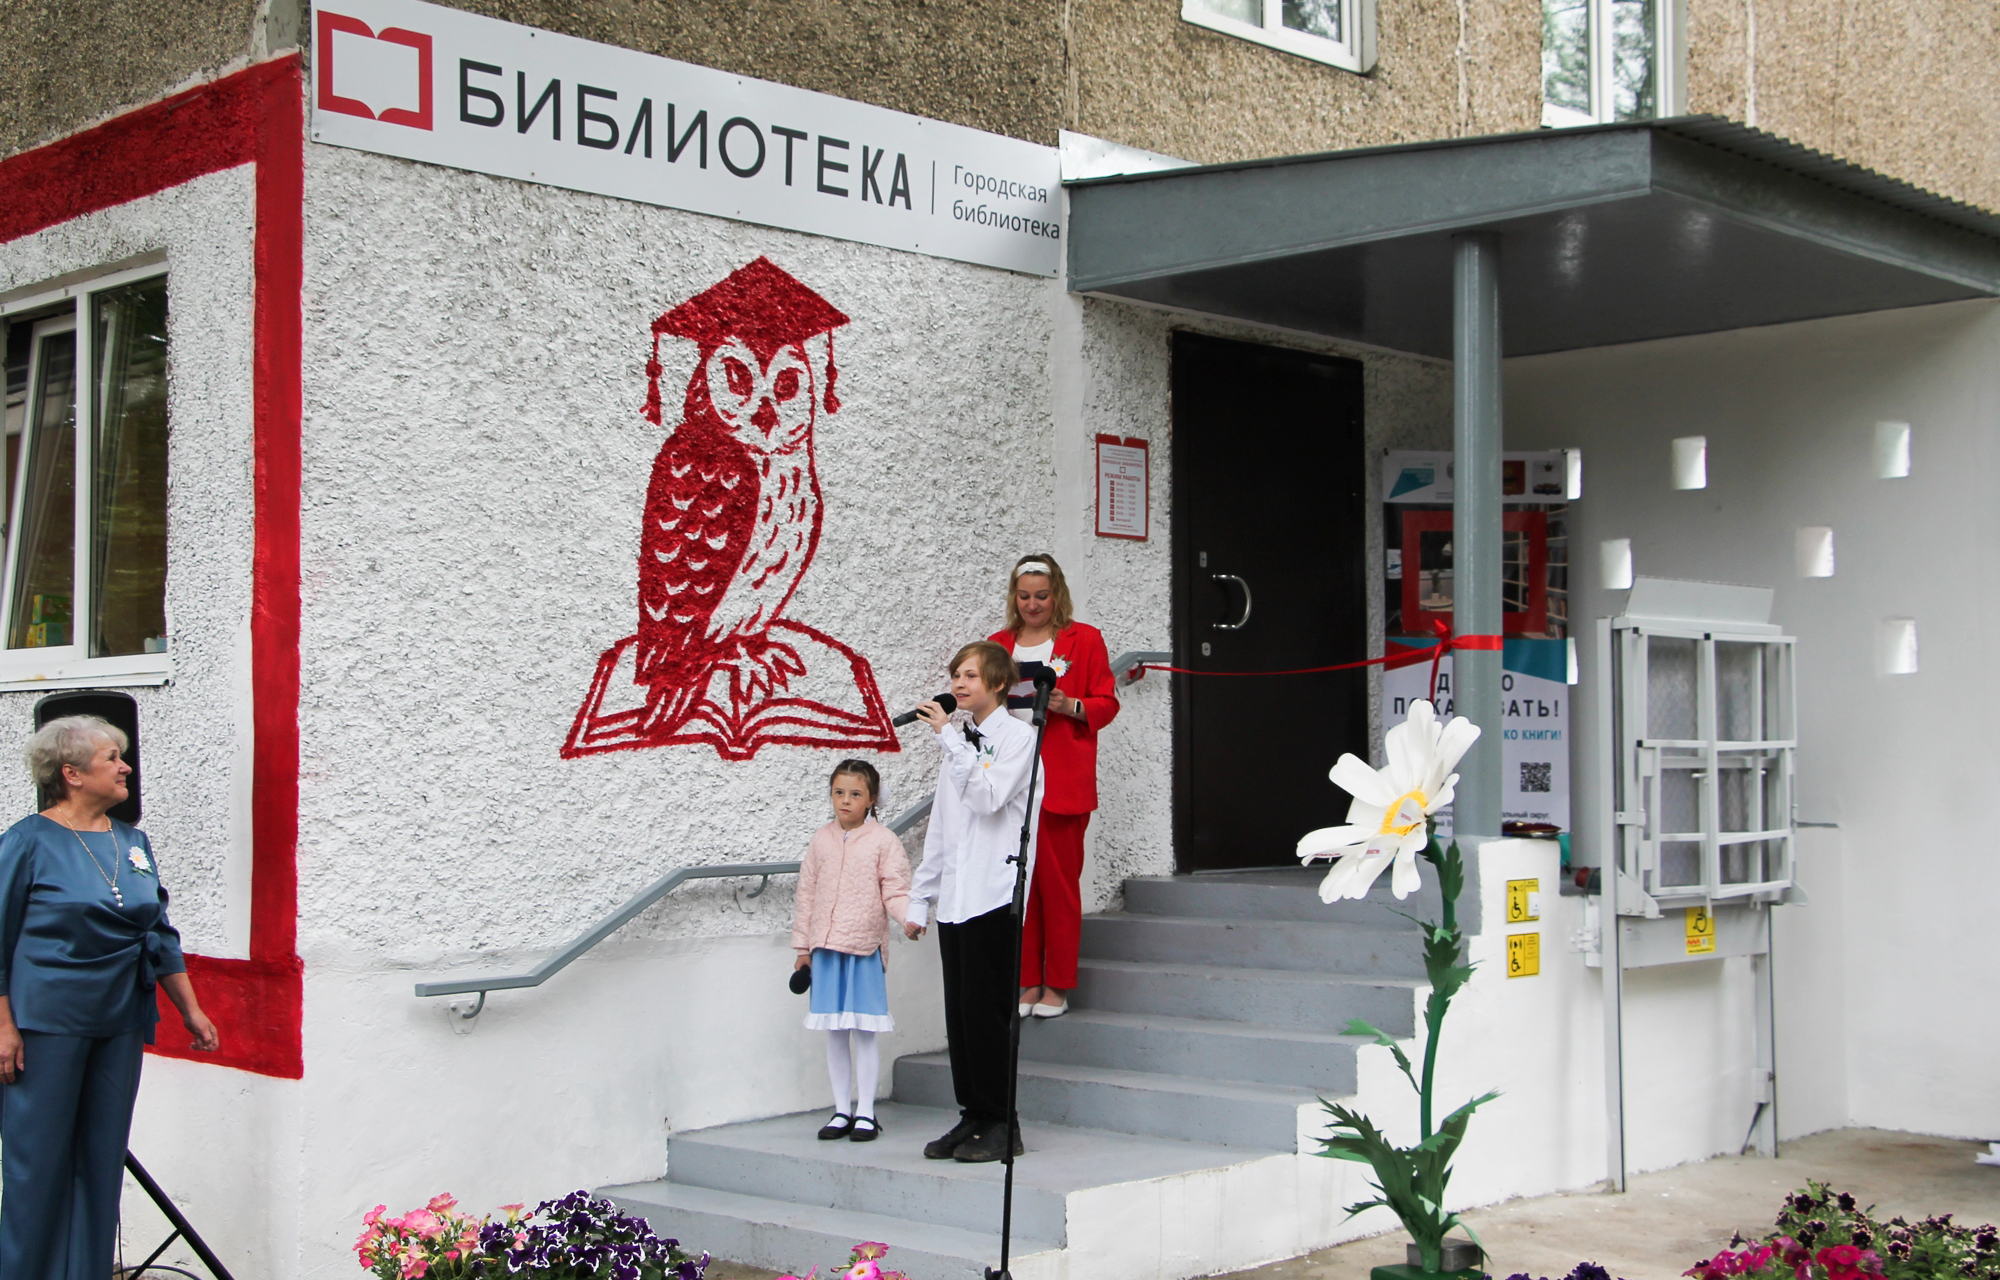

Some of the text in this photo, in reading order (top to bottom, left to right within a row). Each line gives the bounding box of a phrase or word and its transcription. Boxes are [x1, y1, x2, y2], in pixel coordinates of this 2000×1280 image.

[459, 57, 912, 211] БИБЛИОТЕКА
[953, 164, 1047, 203] Городская
[952, 199, 1060, 240] библиотека
[1522, 729, 1562, 741] КНИГИ!
